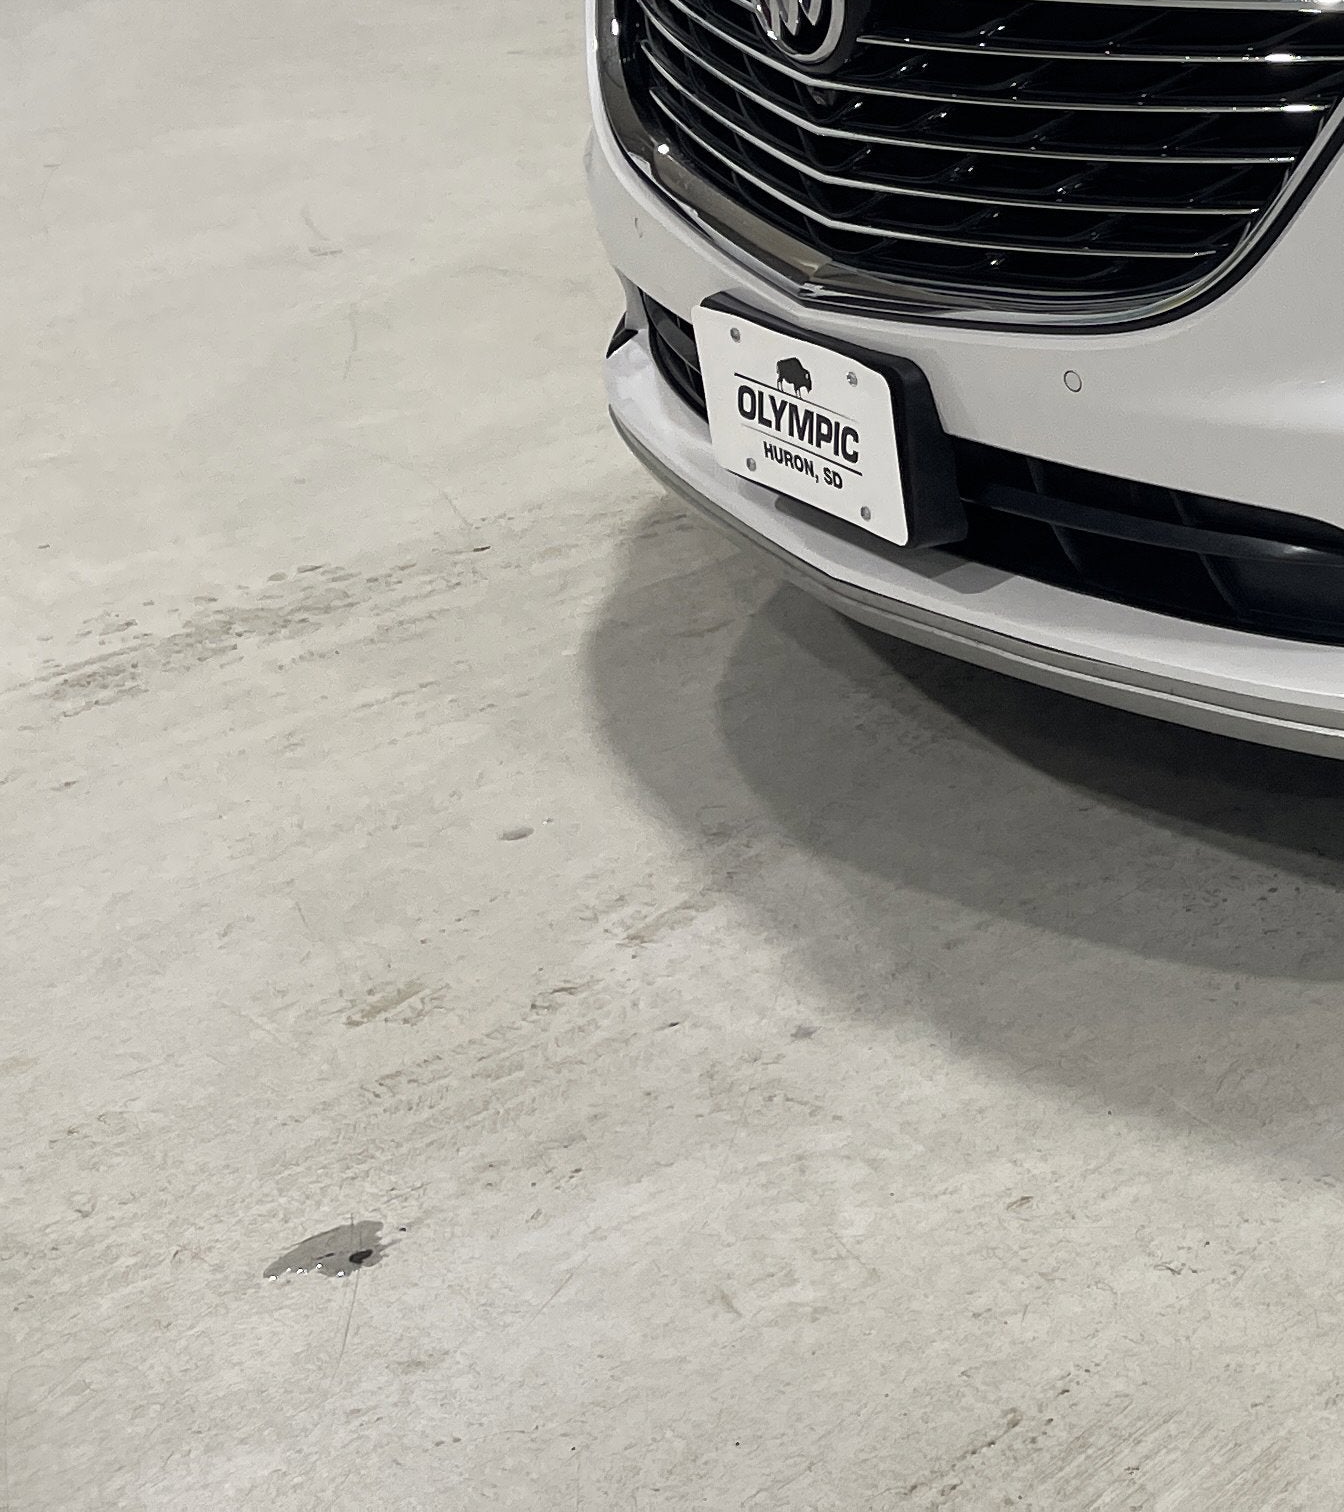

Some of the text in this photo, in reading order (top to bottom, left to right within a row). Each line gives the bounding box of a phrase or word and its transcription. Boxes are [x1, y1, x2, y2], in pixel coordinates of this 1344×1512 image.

[737, 384, 860, 464] OLYMPIC
[763, 440, 843, 490] HURON, SD
